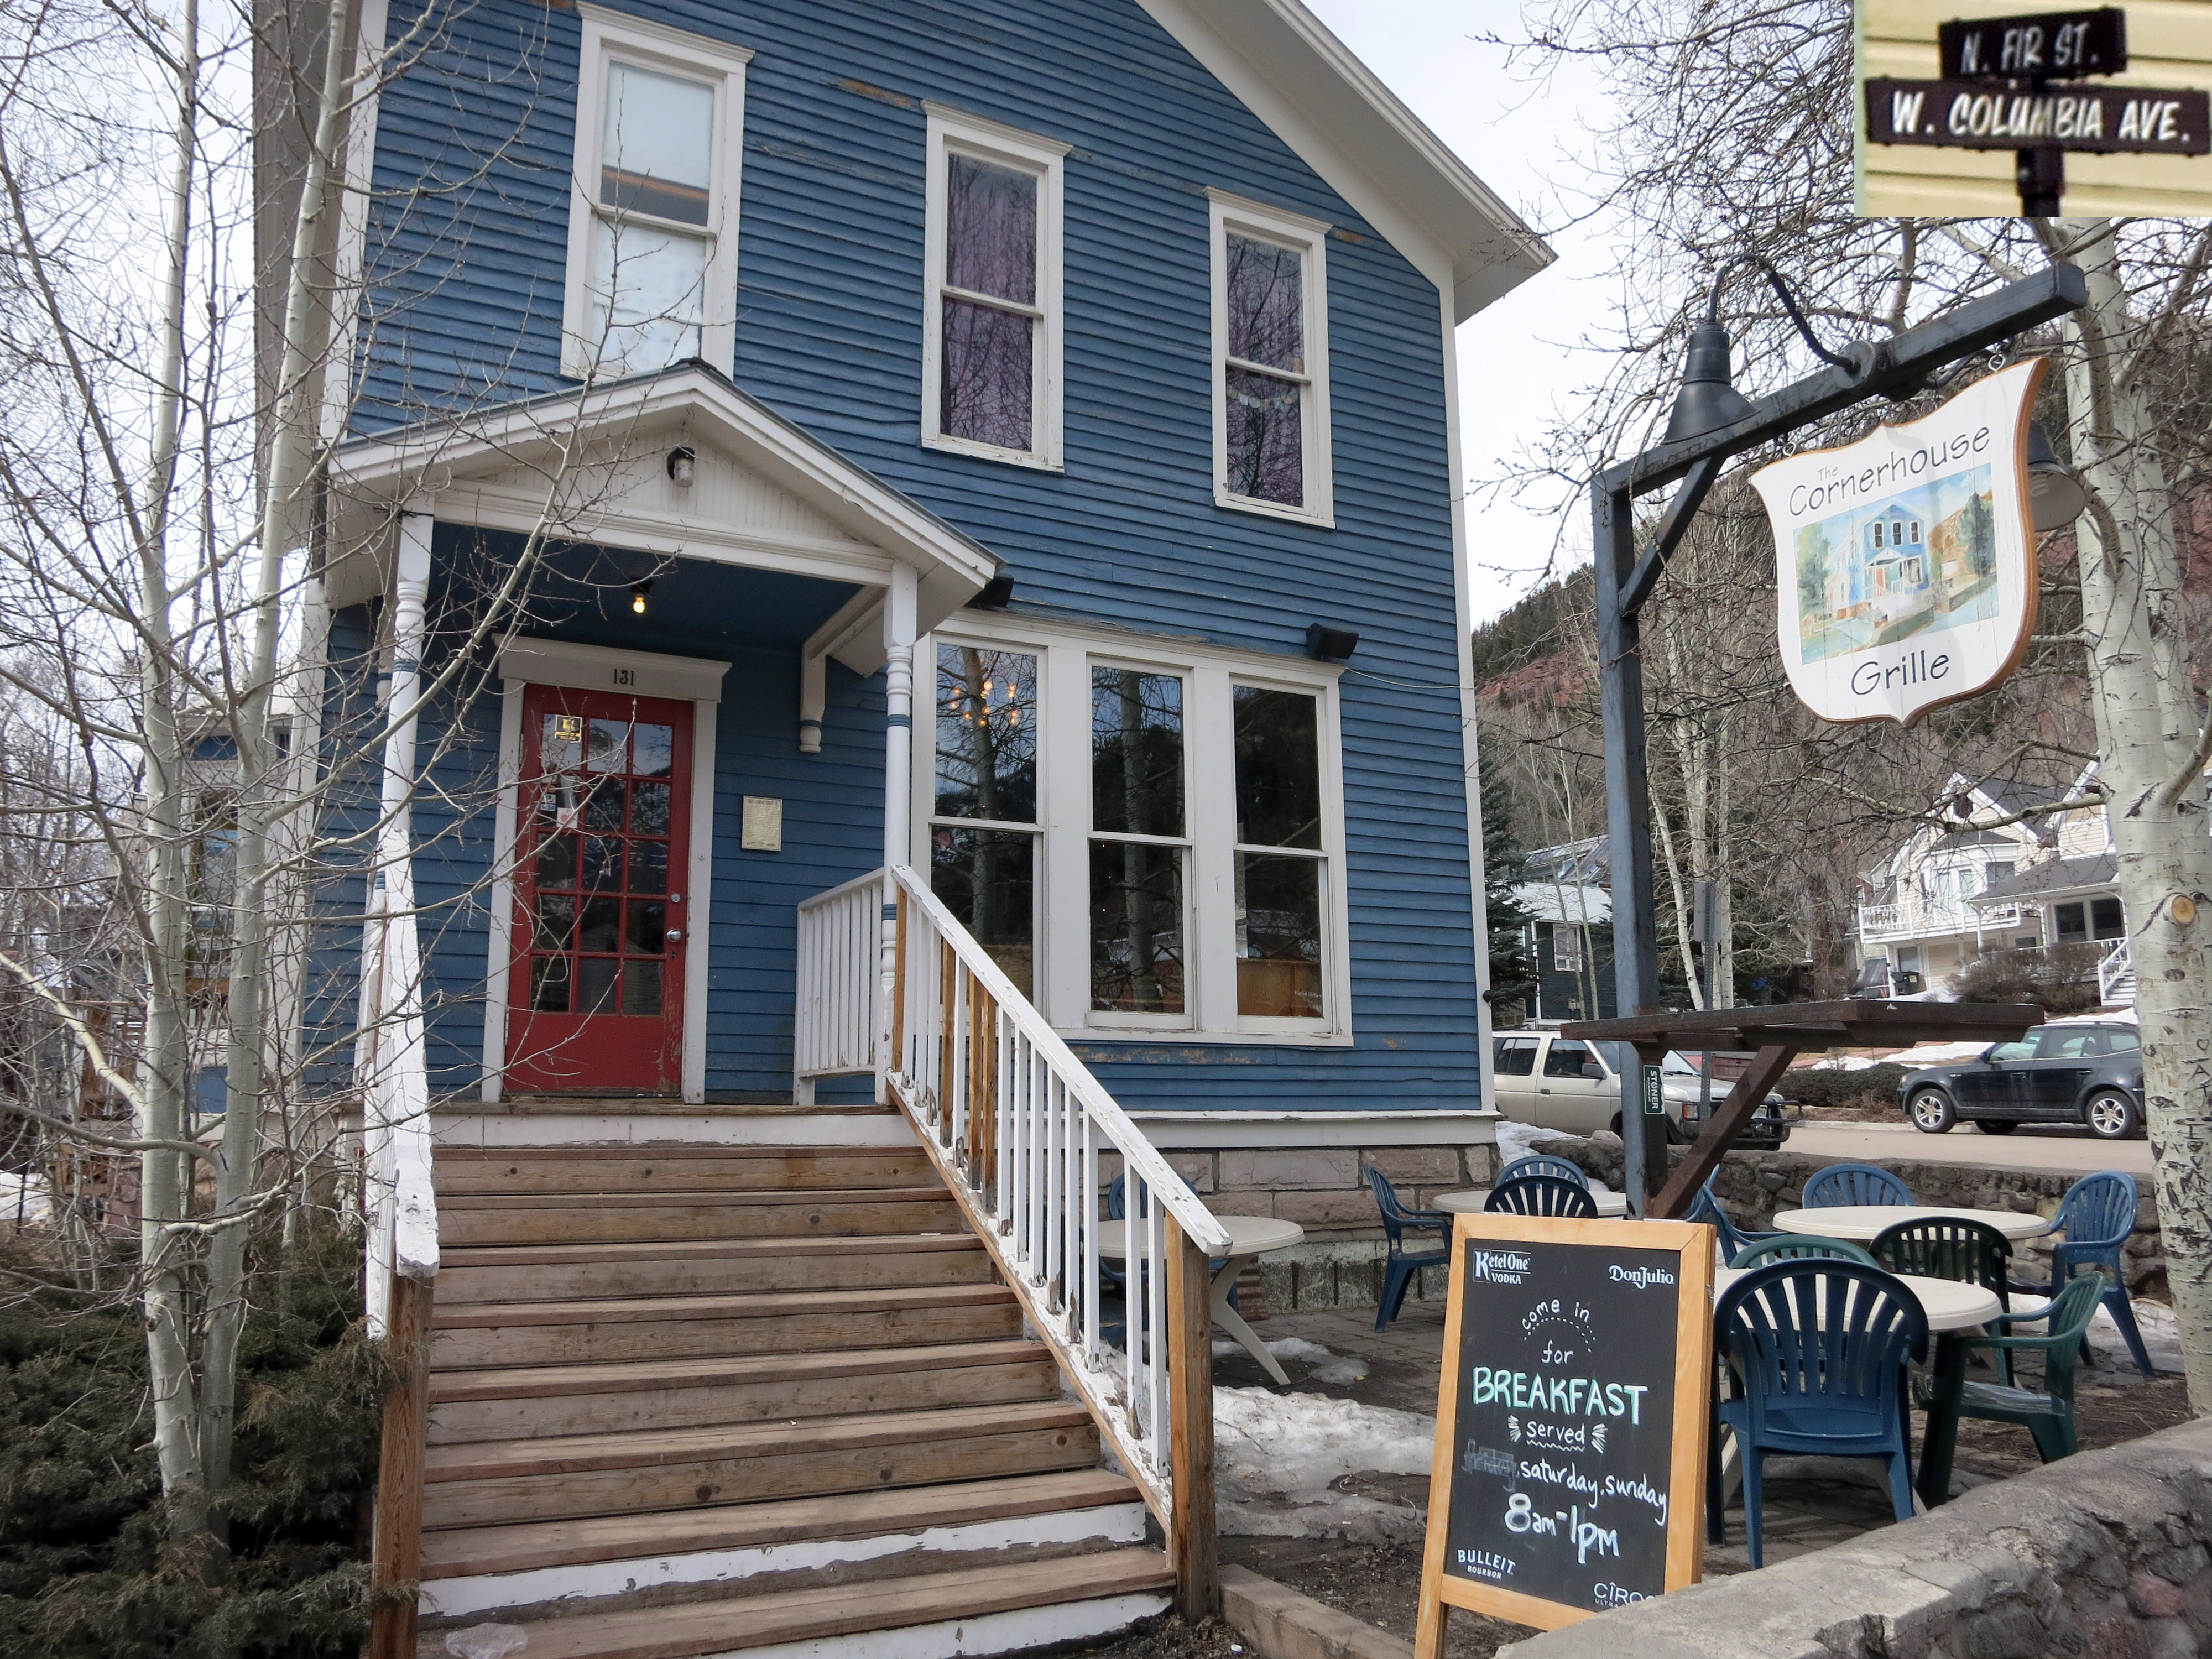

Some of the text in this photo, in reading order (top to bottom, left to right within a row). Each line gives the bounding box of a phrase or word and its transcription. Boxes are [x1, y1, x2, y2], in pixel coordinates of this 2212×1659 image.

[1960, 21, 2099, 74] N. FIR ST.
[1891, 90, 2192, 143] W. COLUMBIA AVE.
[1788, 425, 1990, 517] Cornerhouse
[1816, 465, 1839, 482] The
[613, 669, 635, 686] 131
[1850, 649, 1949, 696] Grille
[1650, 1070, 1658, 1109] STONER
[1491, 1272, 1522, 1285] VODKA
[1521, 1298, 1590, 1330] come in
[1541, 1339, 1574, 1364] for
[1473, 1366, 1648, 1425] BREAKFAST
[1457, 1549, 1516, 1575] BULLEIT
[1467, 1564, 1502, 1580] BOURBON
[1594, 1582, 1655, 1605] CÎRO
[1594, 1598, 1619, 1608] ULTRA
